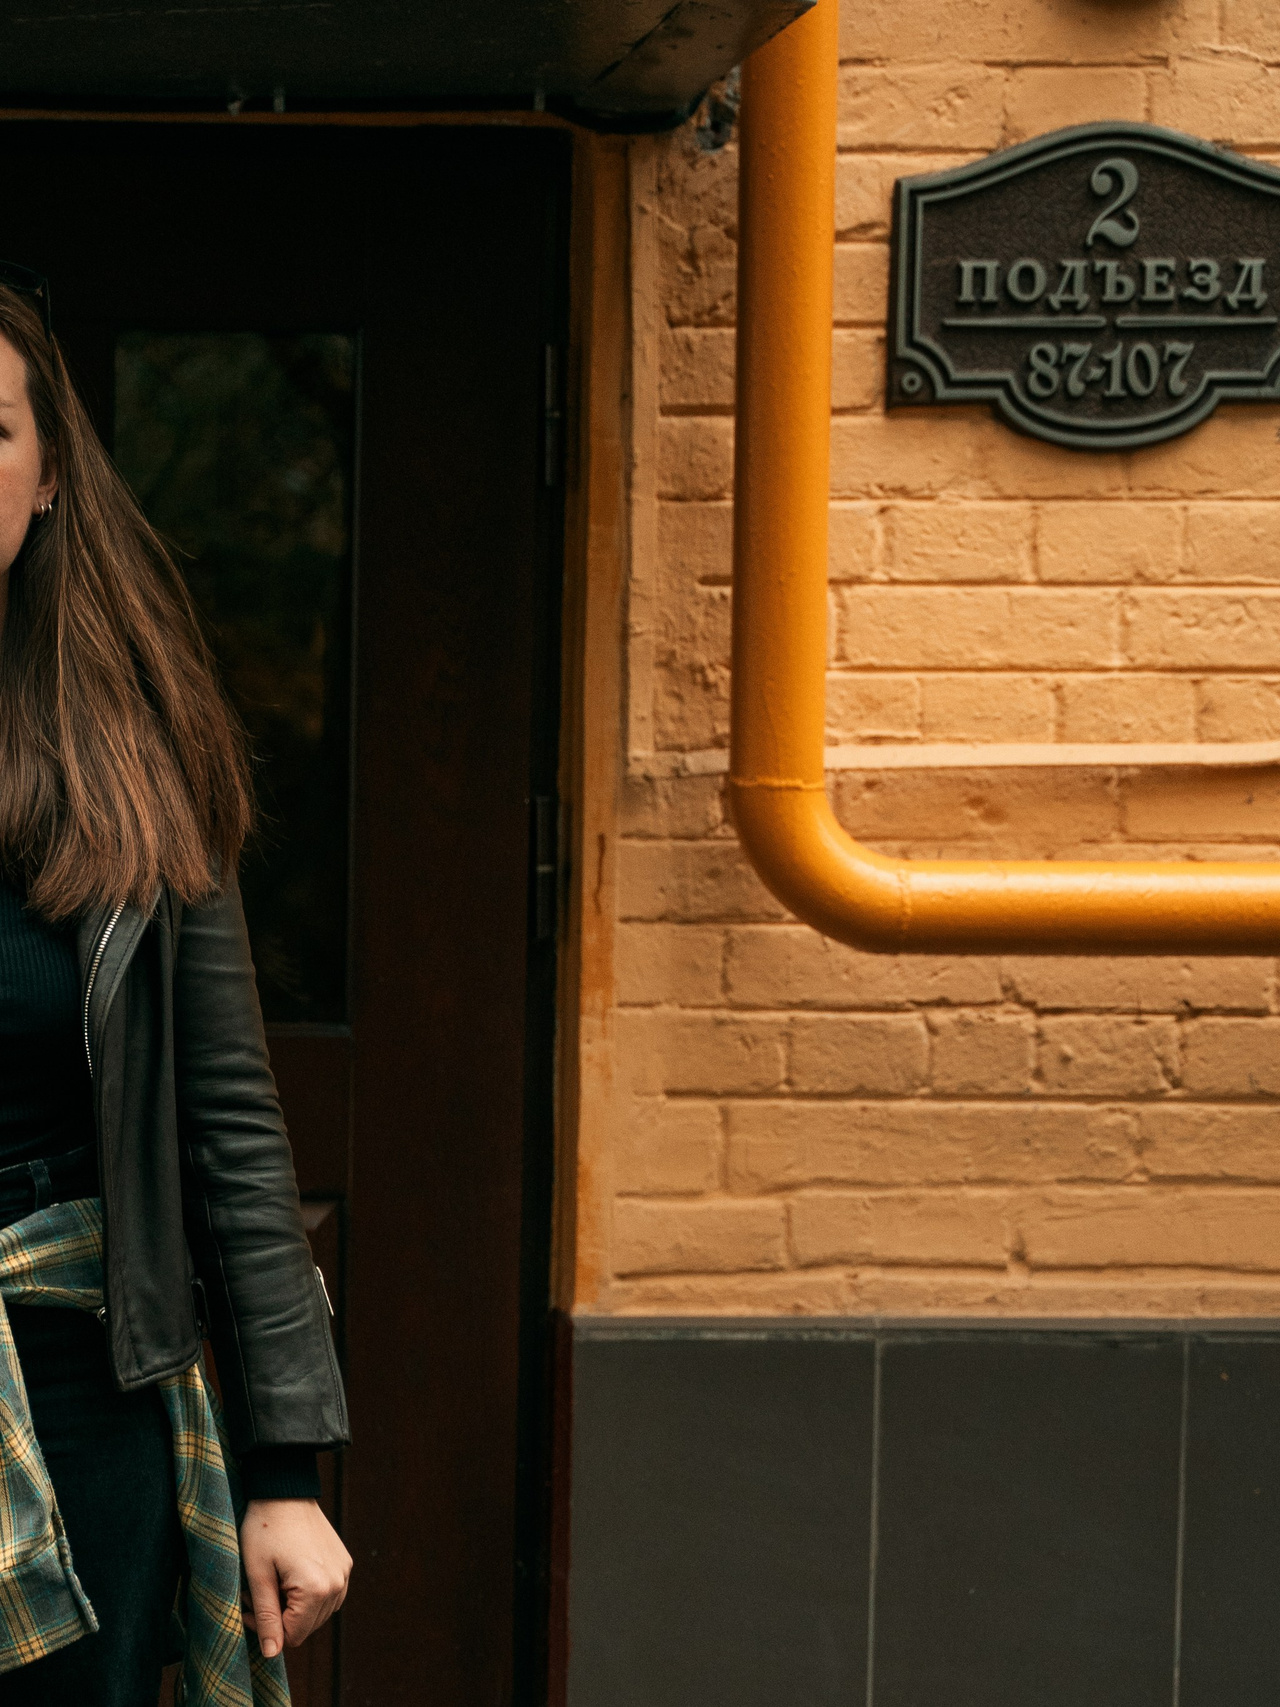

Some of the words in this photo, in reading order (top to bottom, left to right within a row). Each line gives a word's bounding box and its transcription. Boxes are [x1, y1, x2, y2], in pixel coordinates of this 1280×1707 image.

[1086, 158, 1140, 247] 2
[957, 257, 1269, 311] ПОДЪЕЗД
[1026, 341, 1195, 398] 87-107
